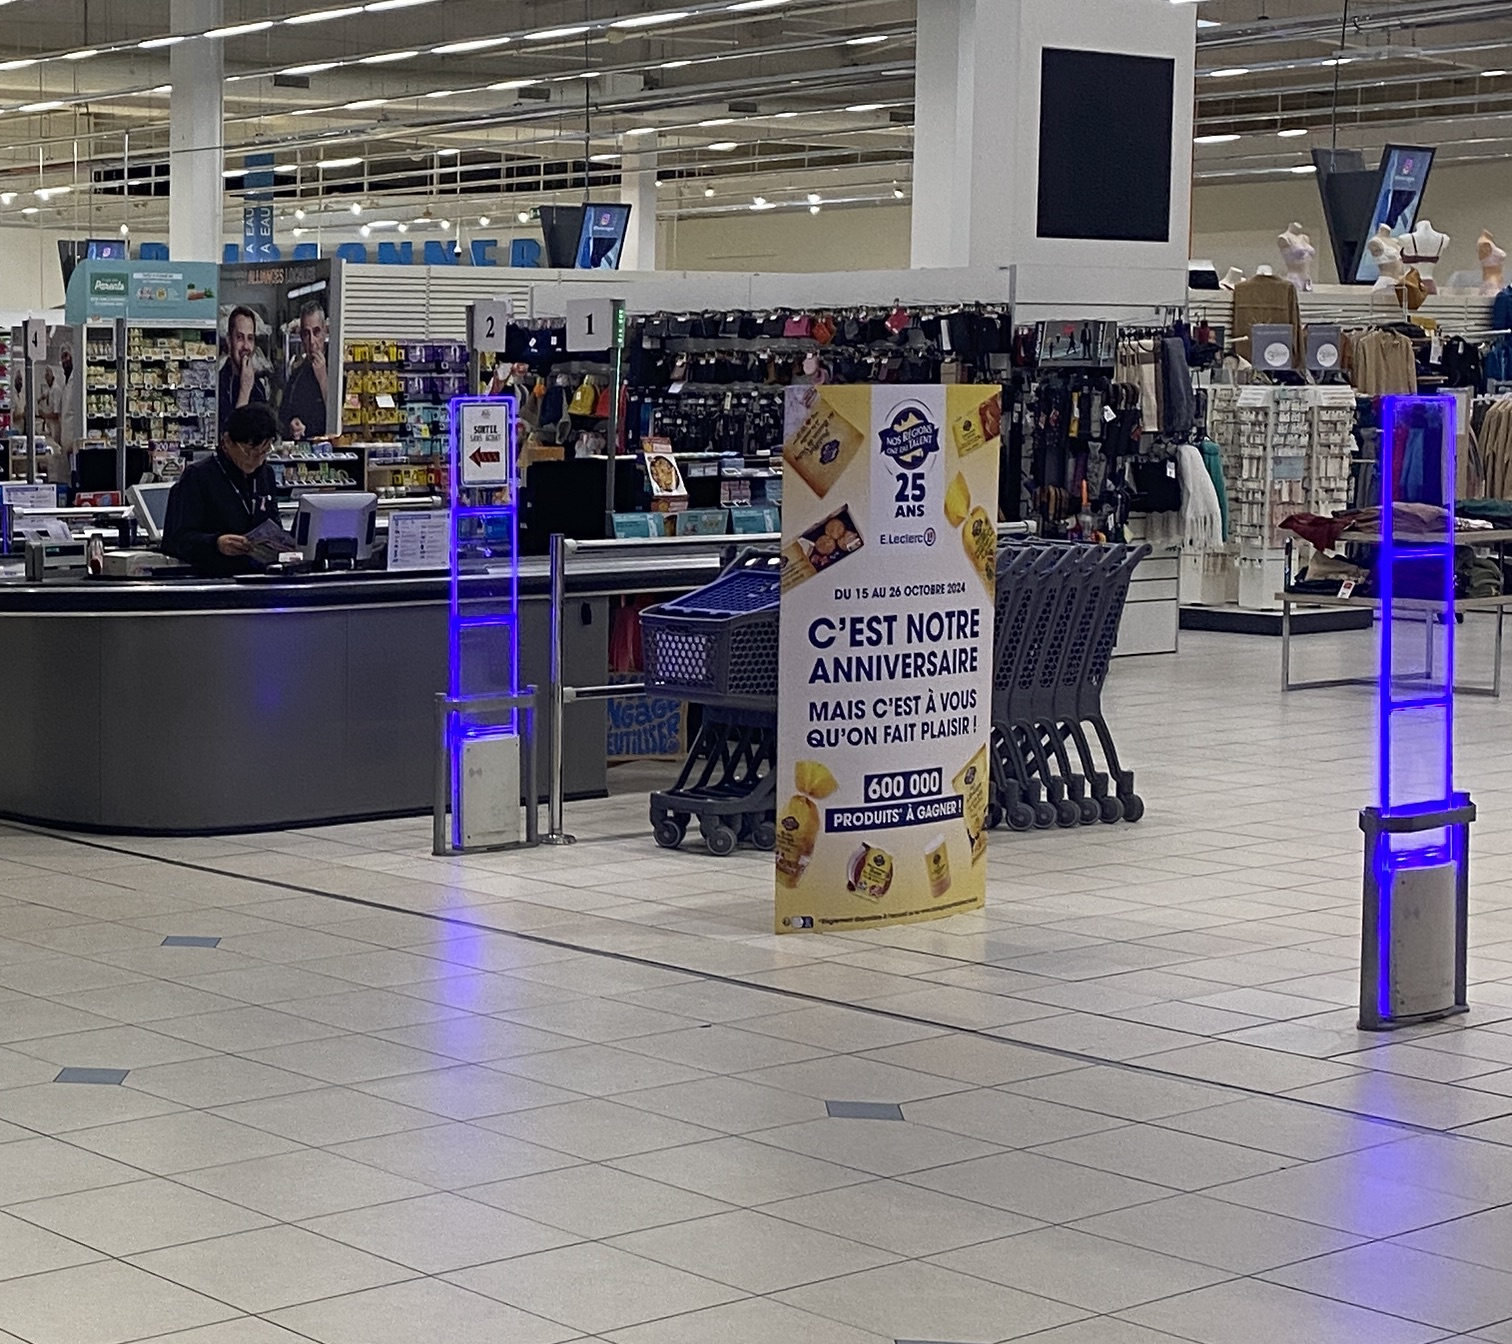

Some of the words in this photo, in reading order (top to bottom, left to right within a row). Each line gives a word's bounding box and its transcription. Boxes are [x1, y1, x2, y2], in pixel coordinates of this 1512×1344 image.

[485, 315, 495, 338] 2
[585, 312, 594, 335] 1
[886, 436, 902, 446] NOS
[895, 472, 926, 503] 25
[895, 504, 925, 518] ANS
[834, 588, 852, 600] DU
[856, 587, 869, 599] 15
[872, 587, 886, 599] AU
[889, 586, 902, 598] 26
[904, 583, 946, 597] OCTOBRE
[947, 582, 966, 594] 2024
[907, 608, 980, 644] NOTRE
[808, 646, 978, 684] ANNIVERSAIRE
[809, 699, 866, 722] MAIS
[925, 688, 937, 714] À
[940, 688, 977, 712] VOUS
[883, 723, 917, 744] FAIT
[921, 716, 970, 741] PLAISIR
[867, 775, 904, 800] 600
[909, 771, 940, 796] 000
[905, 804, 915, 821] À
[917, 801, 957, 820] GAGNER
